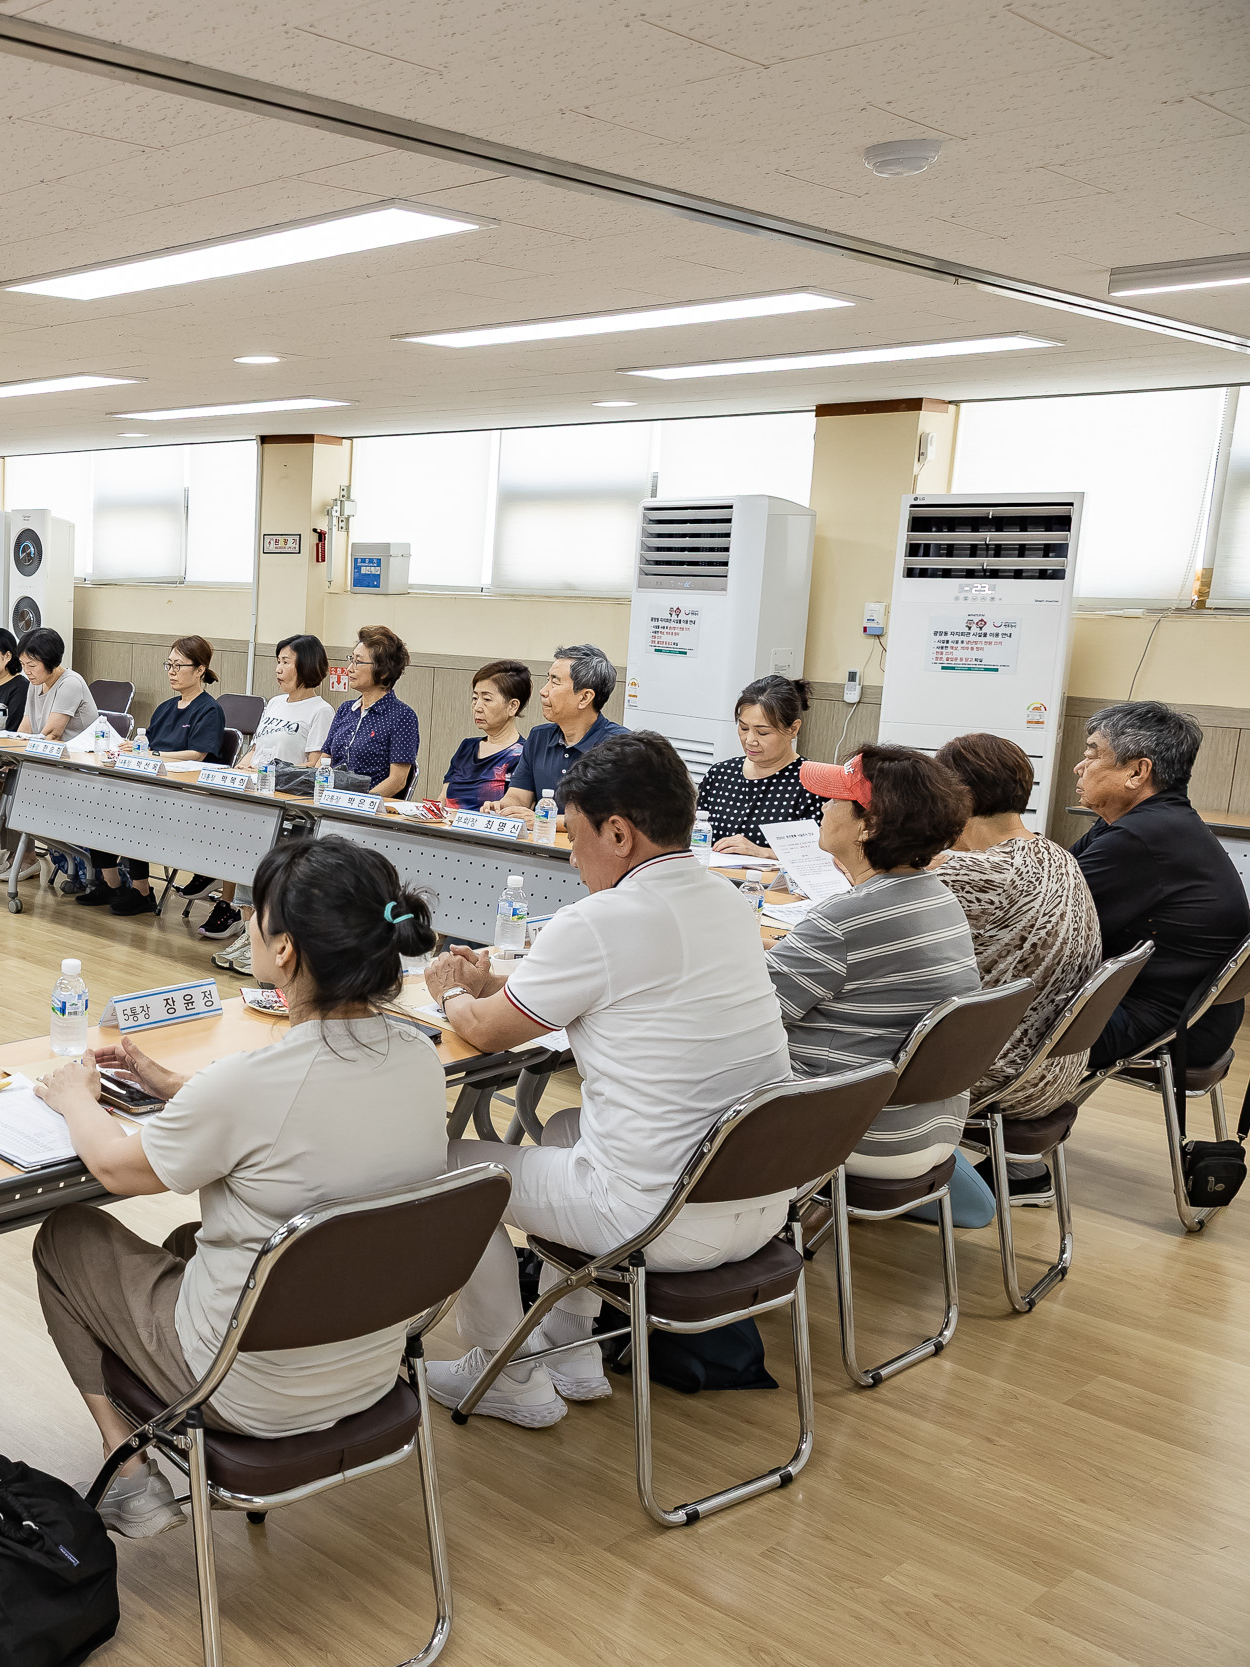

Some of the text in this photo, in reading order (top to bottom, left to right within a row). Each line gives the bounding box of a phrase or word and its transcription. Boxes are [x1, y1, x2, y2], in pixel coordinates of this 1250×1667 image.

[322, 793, 378, 810] 12통장 박은희
[455, 814, 520, 835] 부회장 최명신
[122, 990, 214, 1022] 5통장 장윤정
